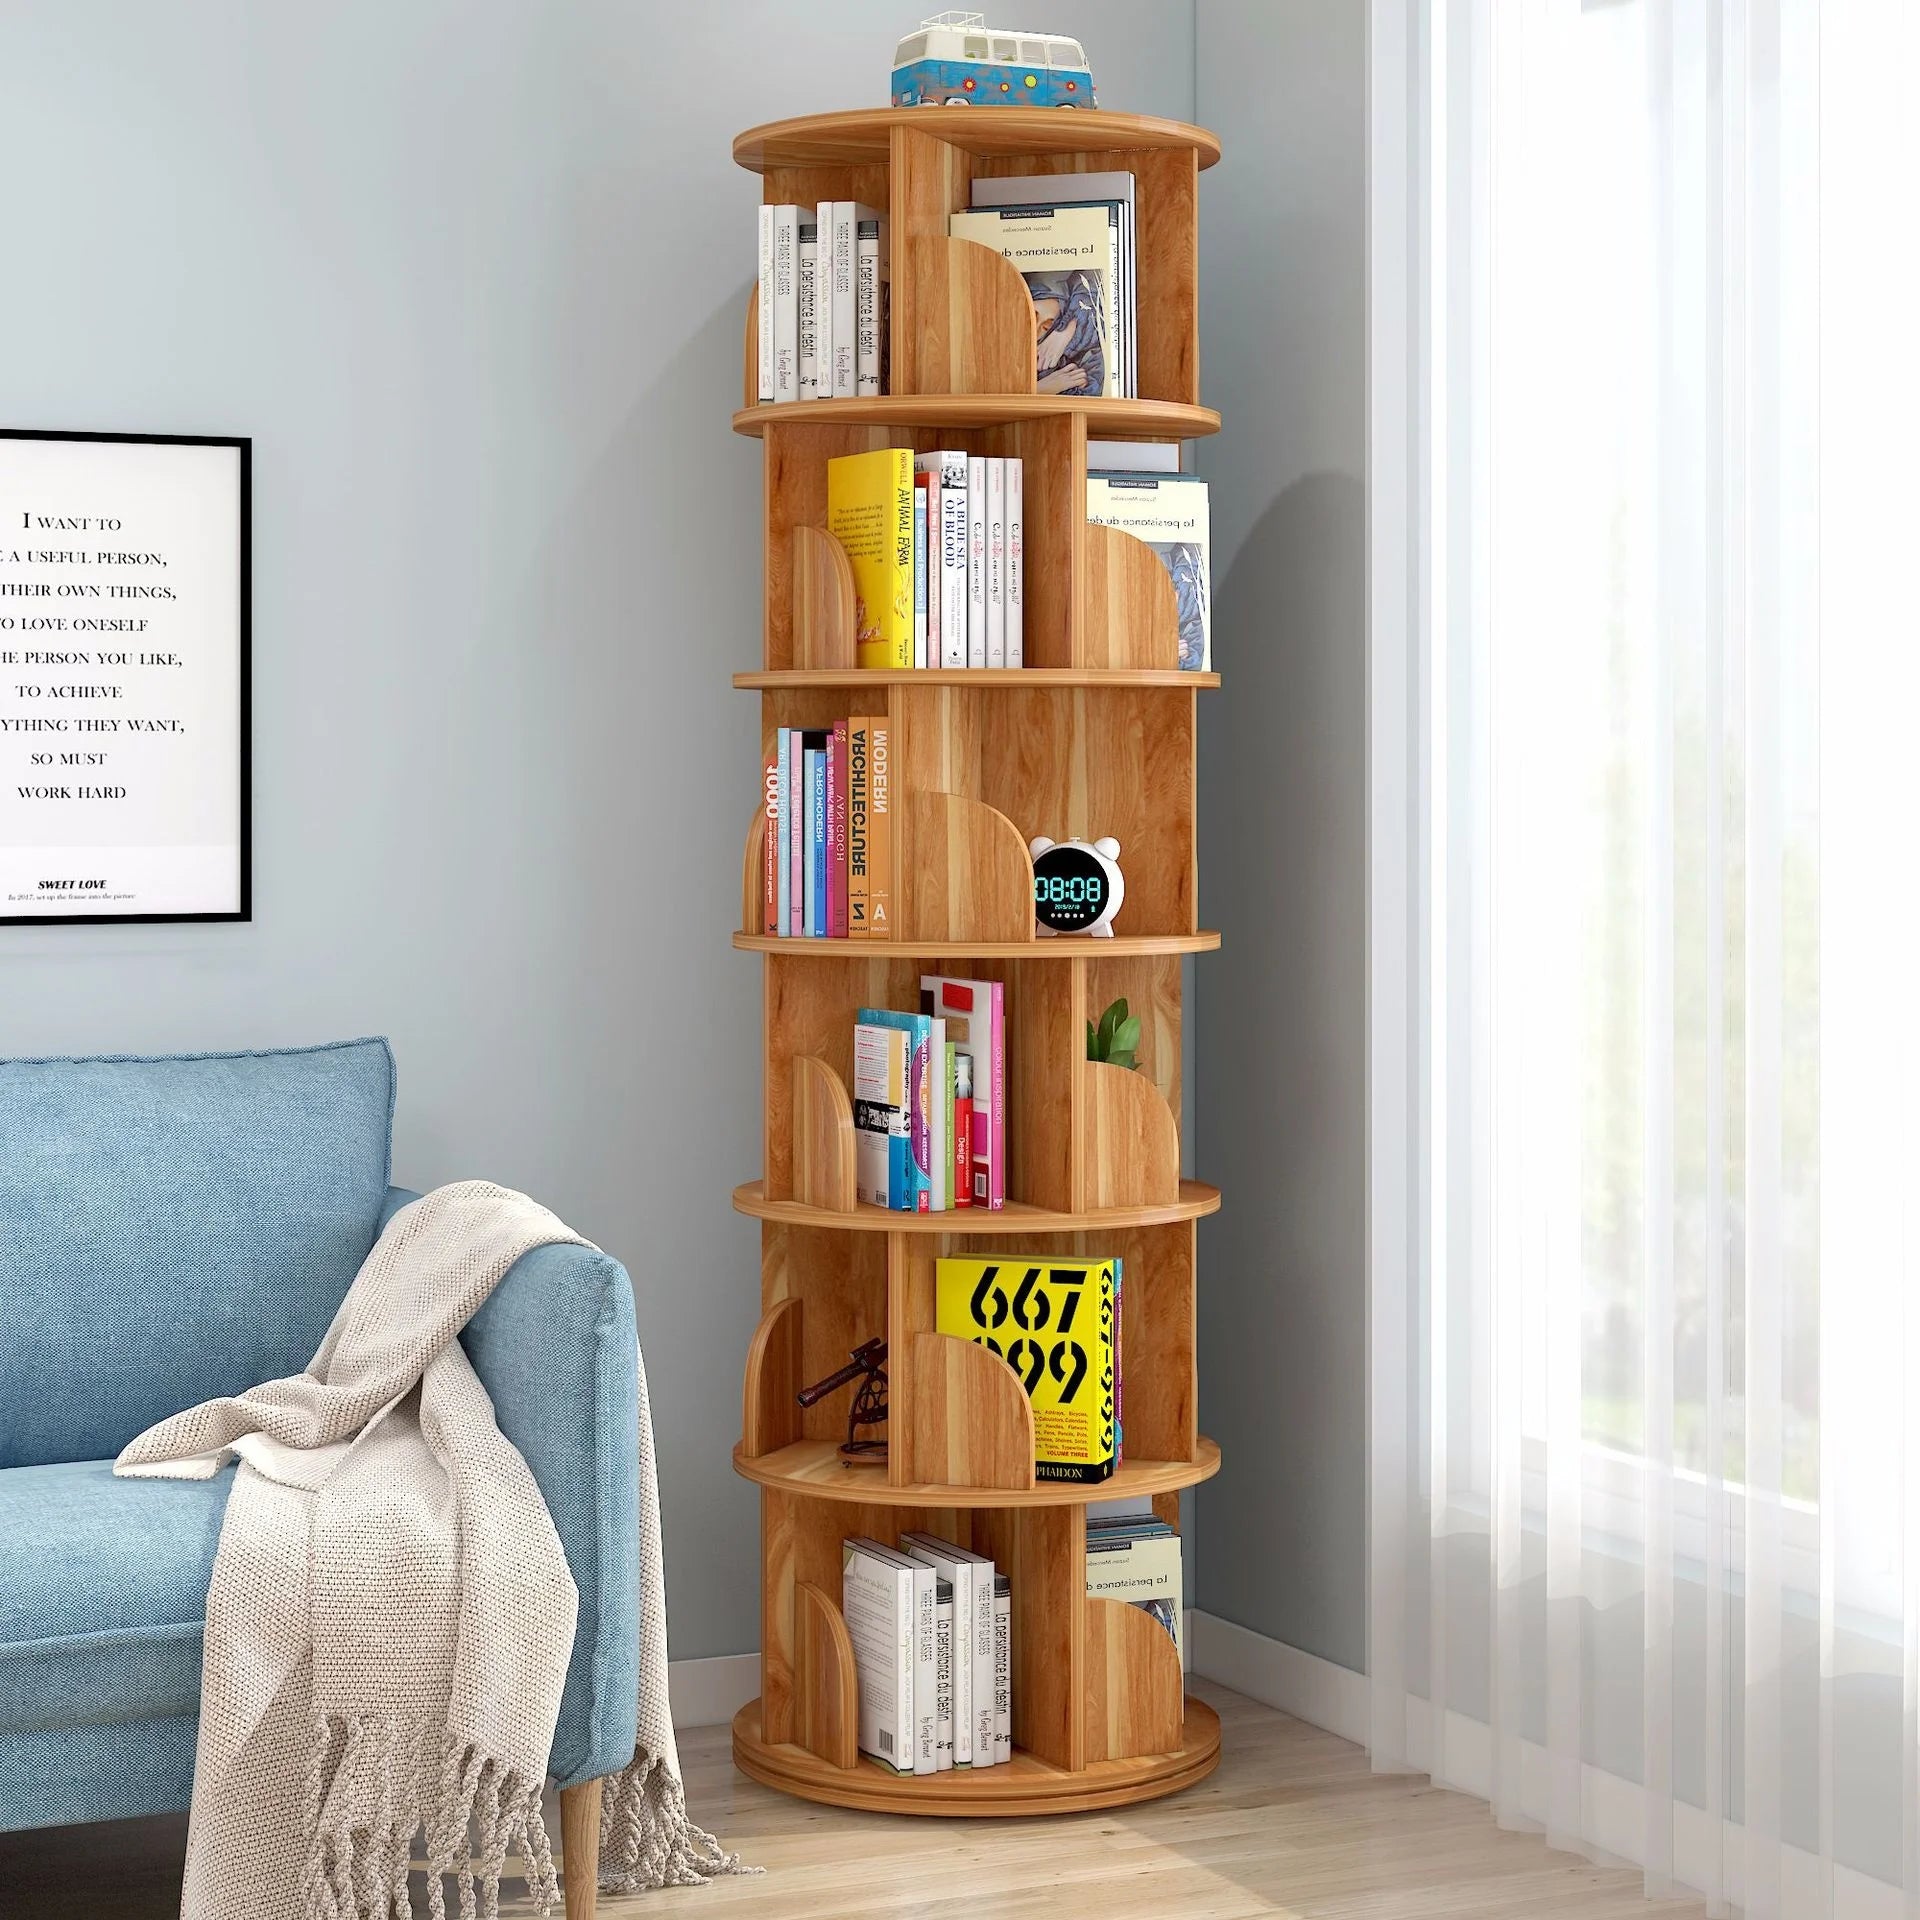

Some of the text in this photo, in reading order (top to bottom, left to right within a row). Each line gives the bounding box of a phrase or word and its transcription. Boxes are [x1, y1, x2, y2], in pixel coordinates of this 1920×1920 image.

[777, 225, 790, 296] THREE PAIRS OF GLASSES
[836, 222, 849, 293] THREE PAIRS OF GLASSES
[860, 254, 878, 355] La persistance du destin
[899, 452, 908, 485] ORWELL
[24, 512, 121, 531] I WANT TO
[897, 488, 911, 567] ANIMAL FARM
[945, 500, 955, 567] OF BLOOD
[957, 497, 965, 570] A BLUE SEA
[0, 584, 177, 601] THEIR OWN THINGS,
[9, 551, 21, 562] A
[28, 551, 92, 564] USEFUL
[97, 552, 167, 567] PERSON,
[917, 519, 925, 601] Business and Production
[0, 617, 149, 632] O LOVE ONESELF
[15, 685, 123, 698] TO ACHIEVE
[25, 652, 183, 667] PERSON YOU LIKE,
[30, 753, 108, 765] SO MUST
[73, 720, 121, 732] THEY
[127, 720, 185, 734] WANT,
[17, 786, 127, 799] WORK HARD
[38, 880, 107, 890] SWEET LOVE
[1034, 876, 1101, 902] 08:08
[994, 1046, 1003, 1125] colour inspiration
[970, 1266, 1088, 1333] 667
[972, 1335, 1088, 1404] 99
[1101, 1267, 1113, 1453] 667-999
[1036, 1466, 1083, 1479] PHAIDON
[920, 1589, 932, 1663] THREE PAIRS OF GLASSES
[978, 1583, 990, 1656] THREE PAIRS OF GLASSES
[937, 1618, 953, 1721] La persistance du destin
[995, 1613, 1010, 1714] La persistance du destin
